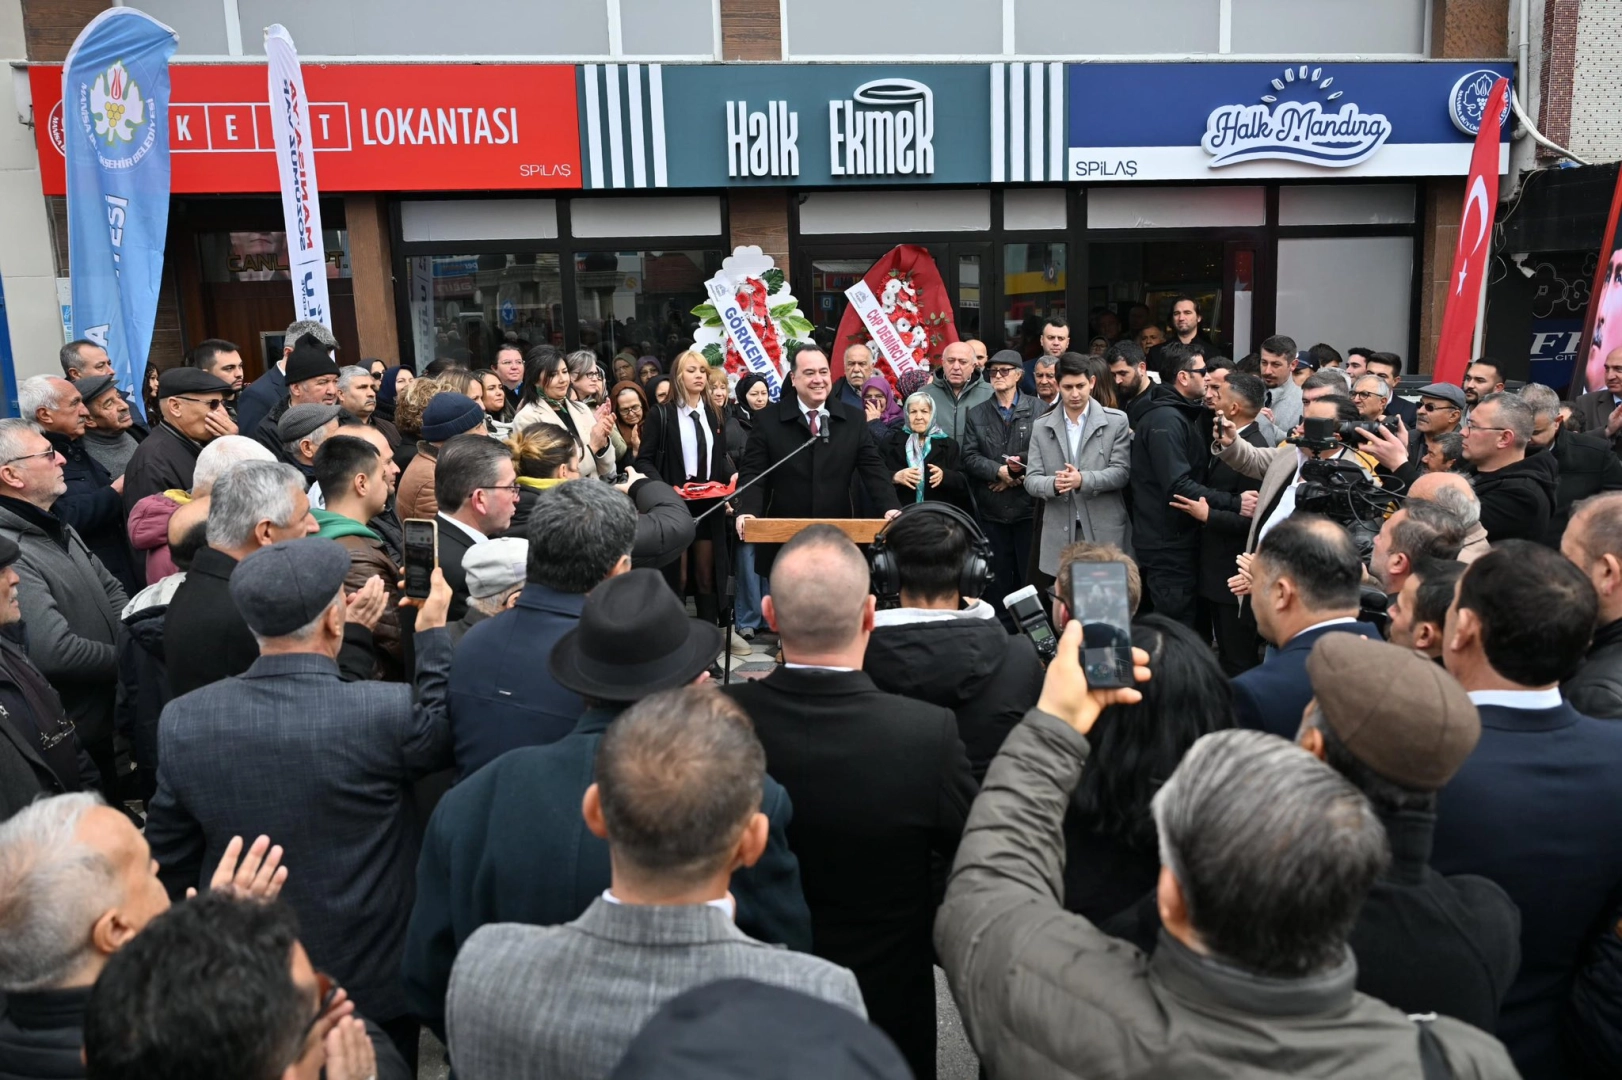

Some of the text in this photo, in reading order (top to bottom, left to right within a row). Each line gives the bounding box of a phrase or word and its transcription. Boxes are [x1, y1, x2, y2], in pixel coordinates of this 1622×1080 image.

[360, 107, 519, 145] LOKANTASI
[726, 79, 934, 177] Halk Ekmek
[1210, 110, 1273, 148] Halk
[724, 306, 766, 371] GÖRKEM
[866, 309, 884, 327] CHP
[876, 325, 908, 362] DEMİRCİ
